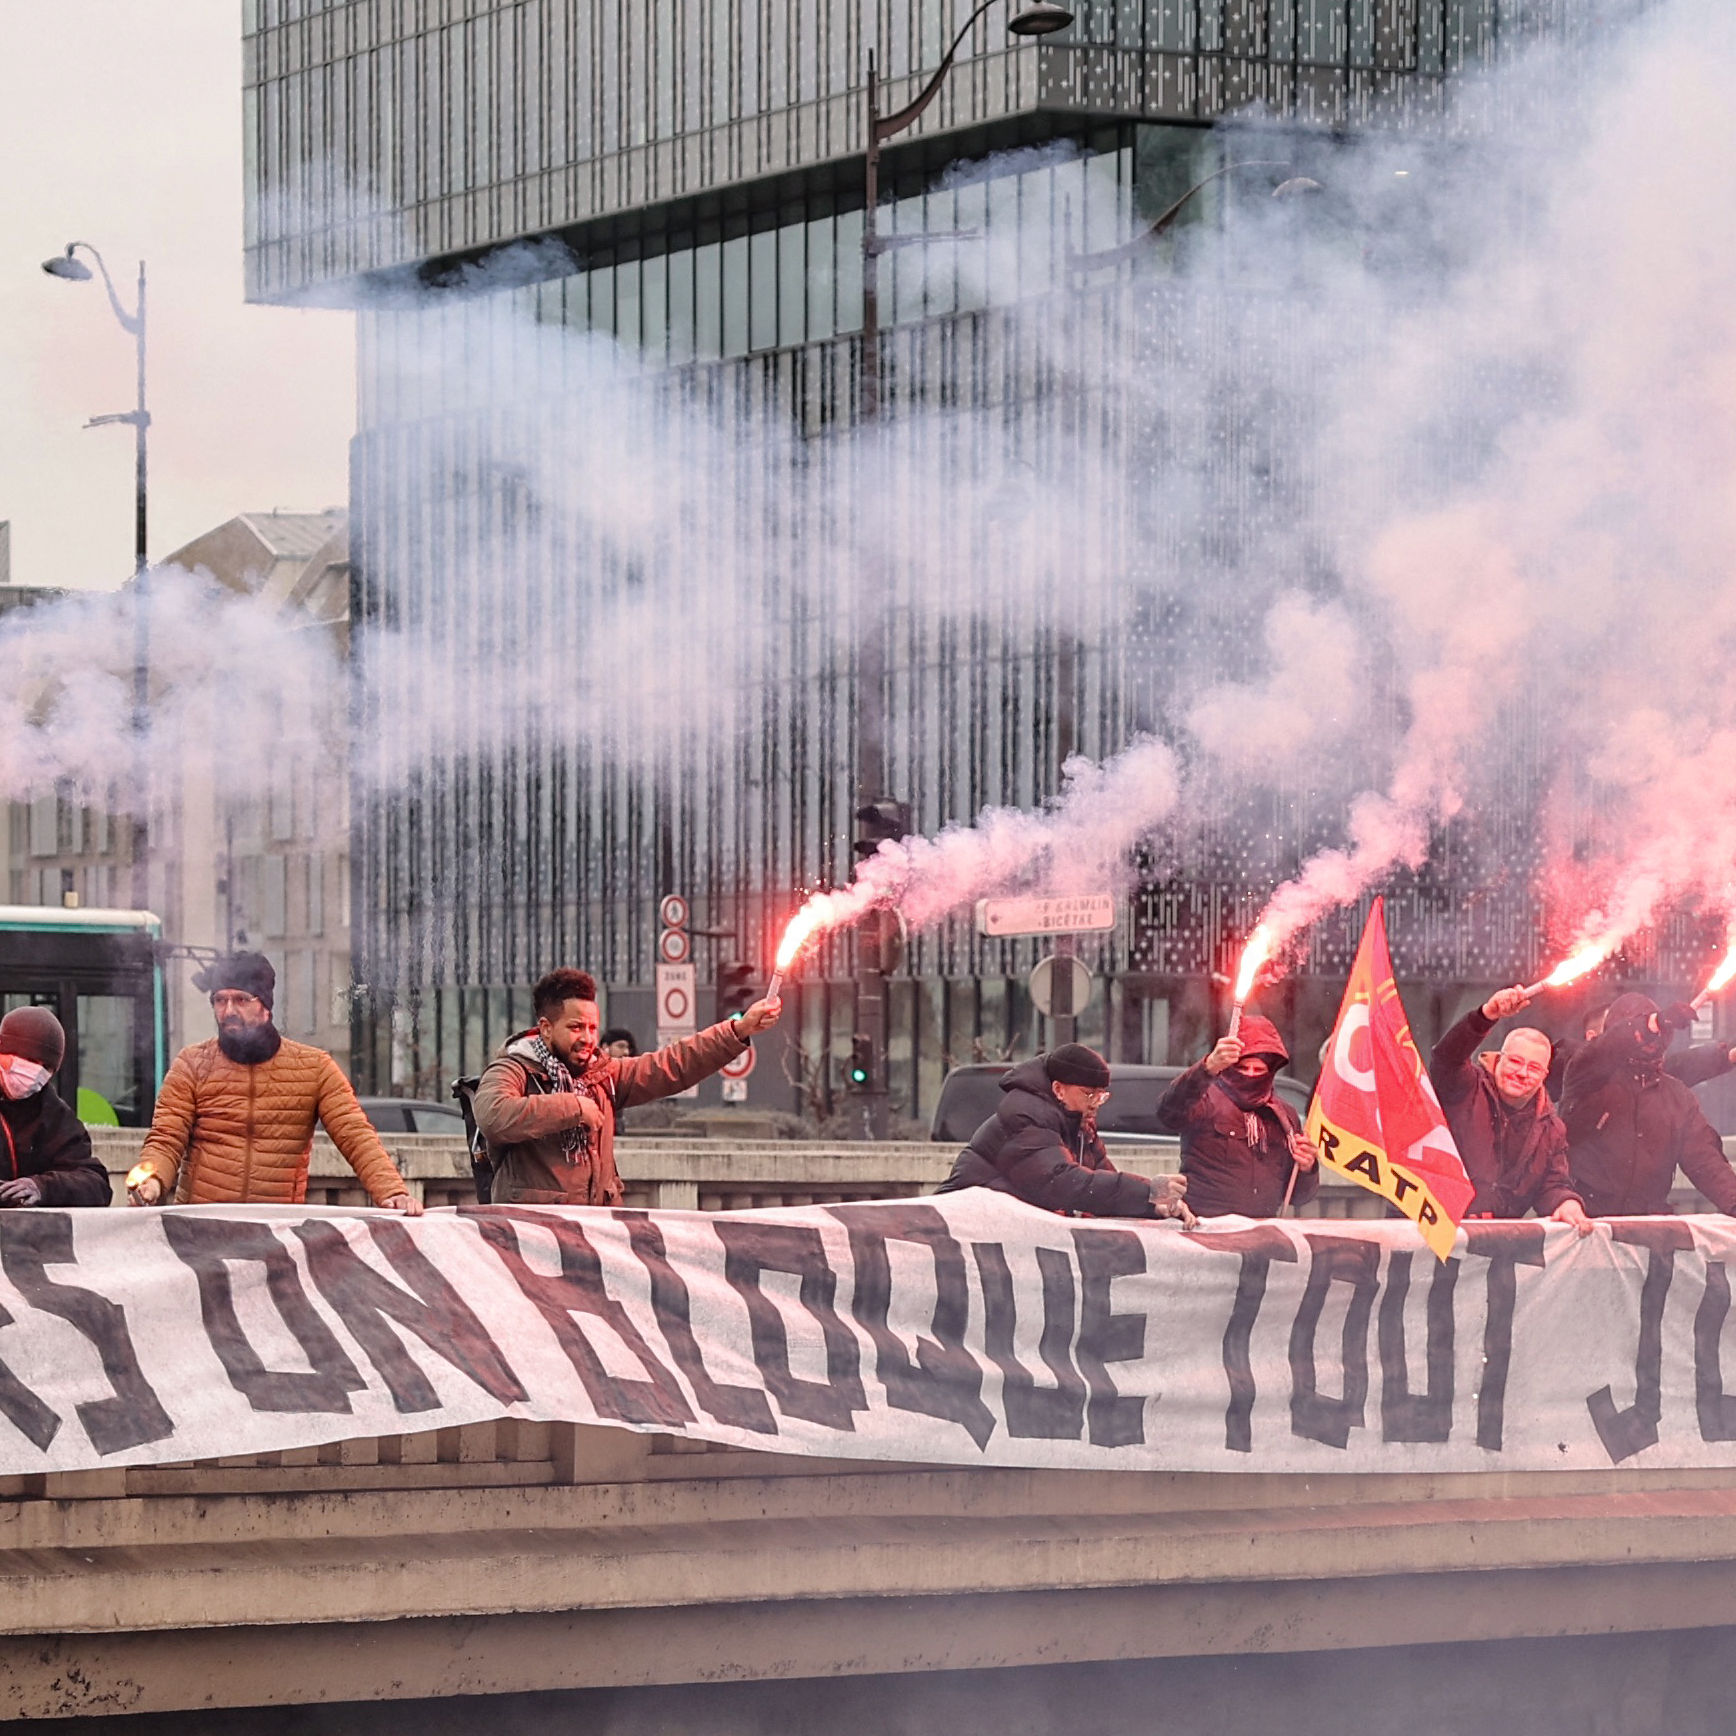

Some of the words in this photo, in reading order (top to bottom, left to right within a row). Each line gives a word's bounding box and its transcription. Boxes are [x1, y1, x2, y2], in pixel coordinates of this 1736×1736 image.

[1318, 1123, 1438, 1228] RATP
[160, 1214, 529, 1415] ON
[456, 1202, 1148, 1454] BLOQUE
[1183, 1220, 1546, 1453] TOUT
